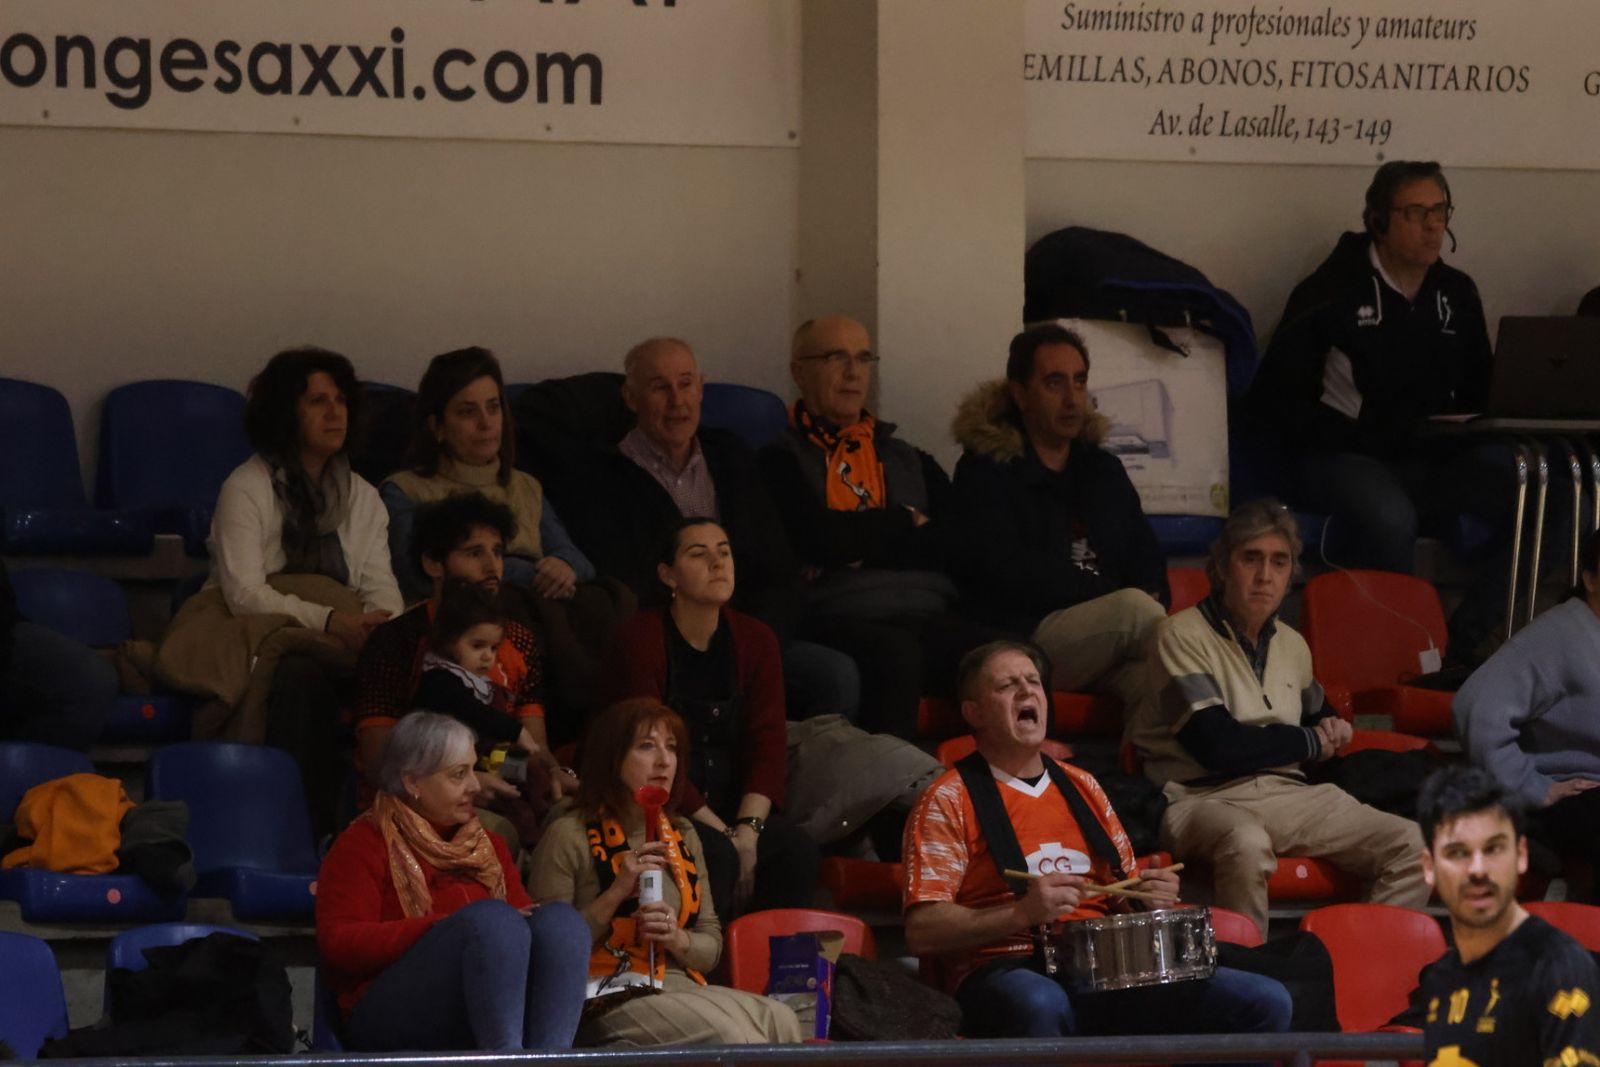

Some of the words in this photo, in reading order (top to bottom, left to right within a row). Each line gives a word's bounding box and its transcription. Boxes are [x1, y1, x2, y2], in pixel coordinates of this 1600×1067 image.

[1060, 1, 1186, 34] Suministro
[1190, 12, 1206, 35] a
[1207, 5, 1351, 48] profesionales
[1353, 17, 1371, 50] y
[1375, 15, 1478, 42] amateurs
[0, 26, 604, 110] ongesaxxi.com
[1154, 57, 1284, 92] ABONOS,
[1288, 60, 1531, 94] FITOSANITARIOS
[1147, 109, 1184, 137] Av.
[1187, 102, 1215, 137] de
[1218, 104, 1300, 143] Lasalle,
[1304, 117, 1393, 146] 143-149
